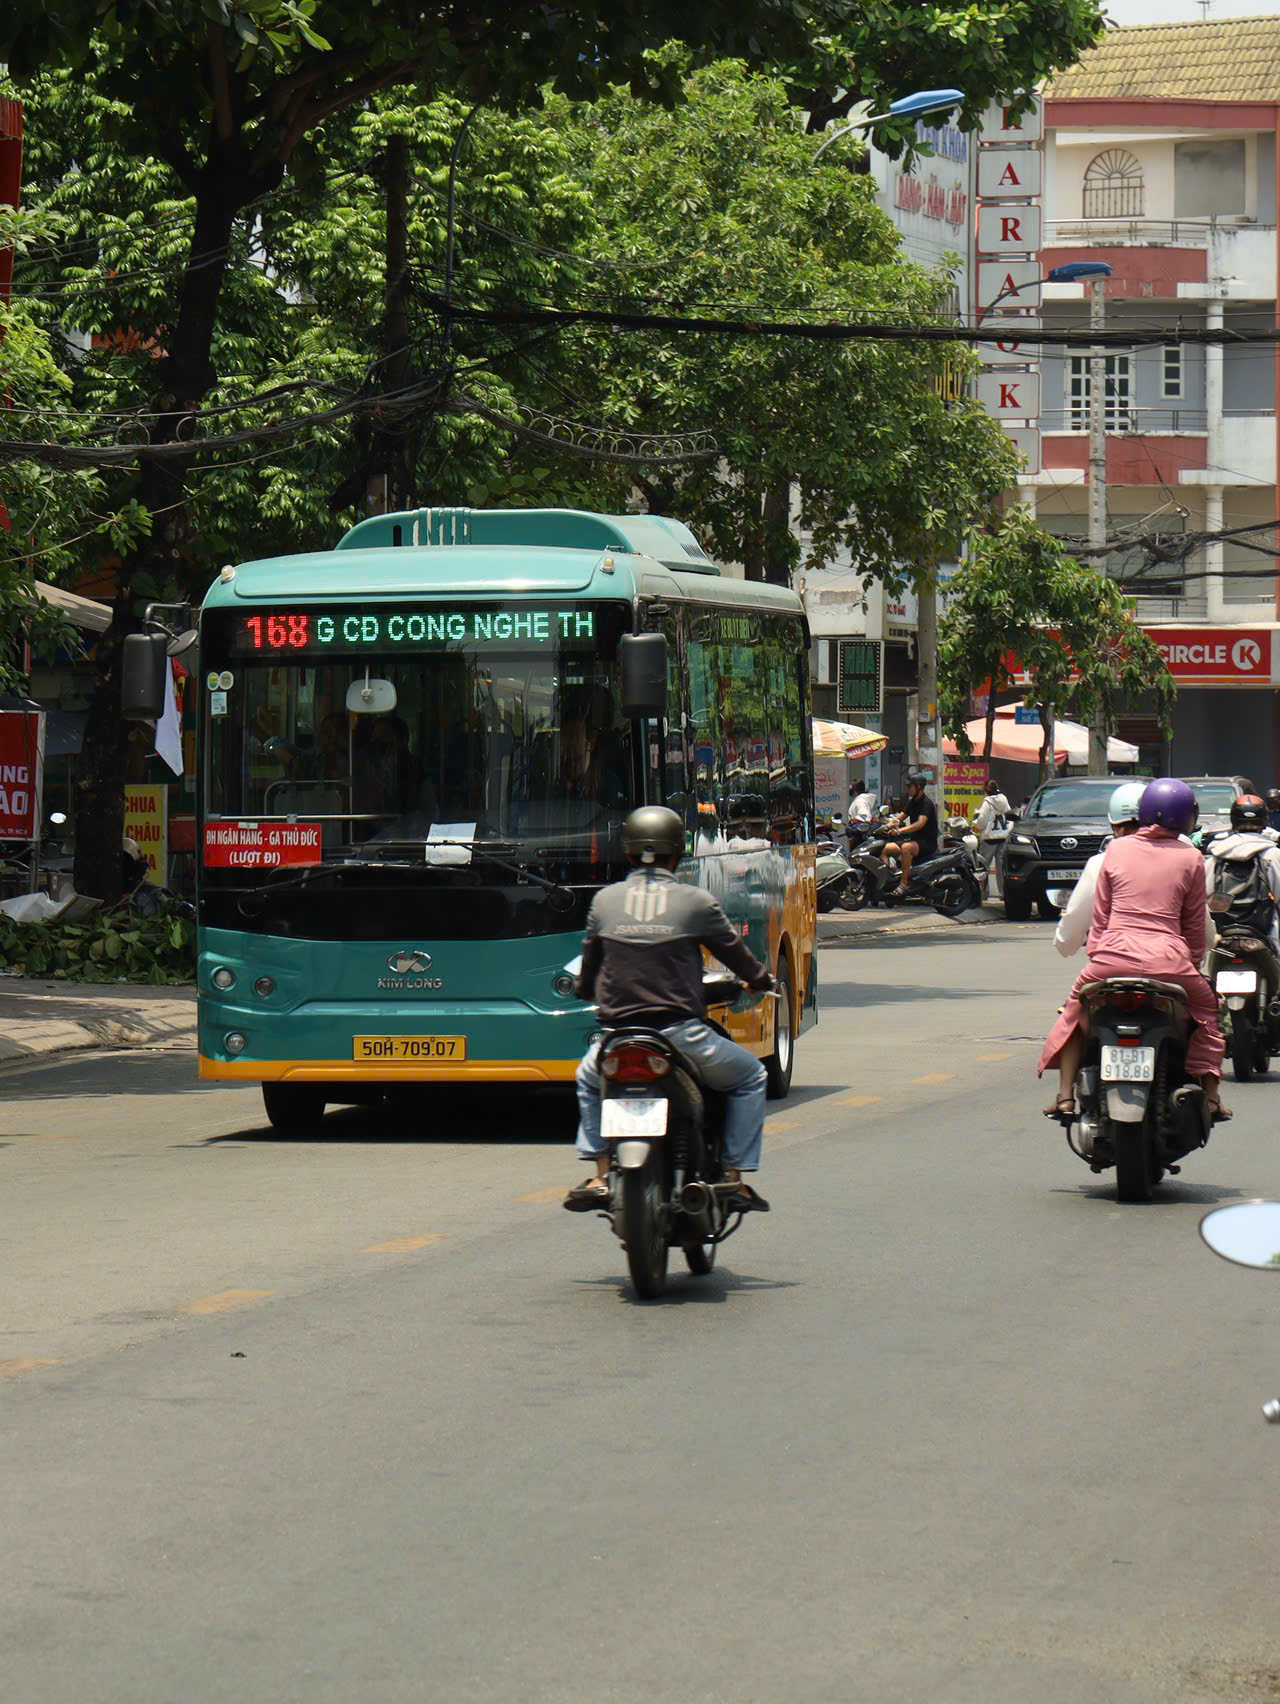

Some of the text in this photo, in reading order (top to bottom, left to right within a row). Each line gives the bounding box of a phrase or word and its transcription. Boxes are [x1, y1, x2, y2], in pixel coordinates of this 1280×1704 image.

[246, 615, 309, 648] 168
[317, 616, 335, 642] G
[343, 616, 379, 642] CĐ
[557, 611, 593, 638] TH
[1159, 644, 1227, 664] CIRCLE
[960, 764, 985, 779] Spa
[217, 828, 239, 845] NGÂN
[269, 831, 281, 845] GA
[282, 827, 299, 846] THỦ
[300, 828, 318, 846] ĐỨC
[263, 851, 281, 866] ĐI)
[377, 977, 443, 989] KIM LONG
[362, 1041, 456, 1056] 50H-709.07
[1111, 1049, 1145, 1064] 81-B1
[1105, 1064, 1150, 1079] 918.88
